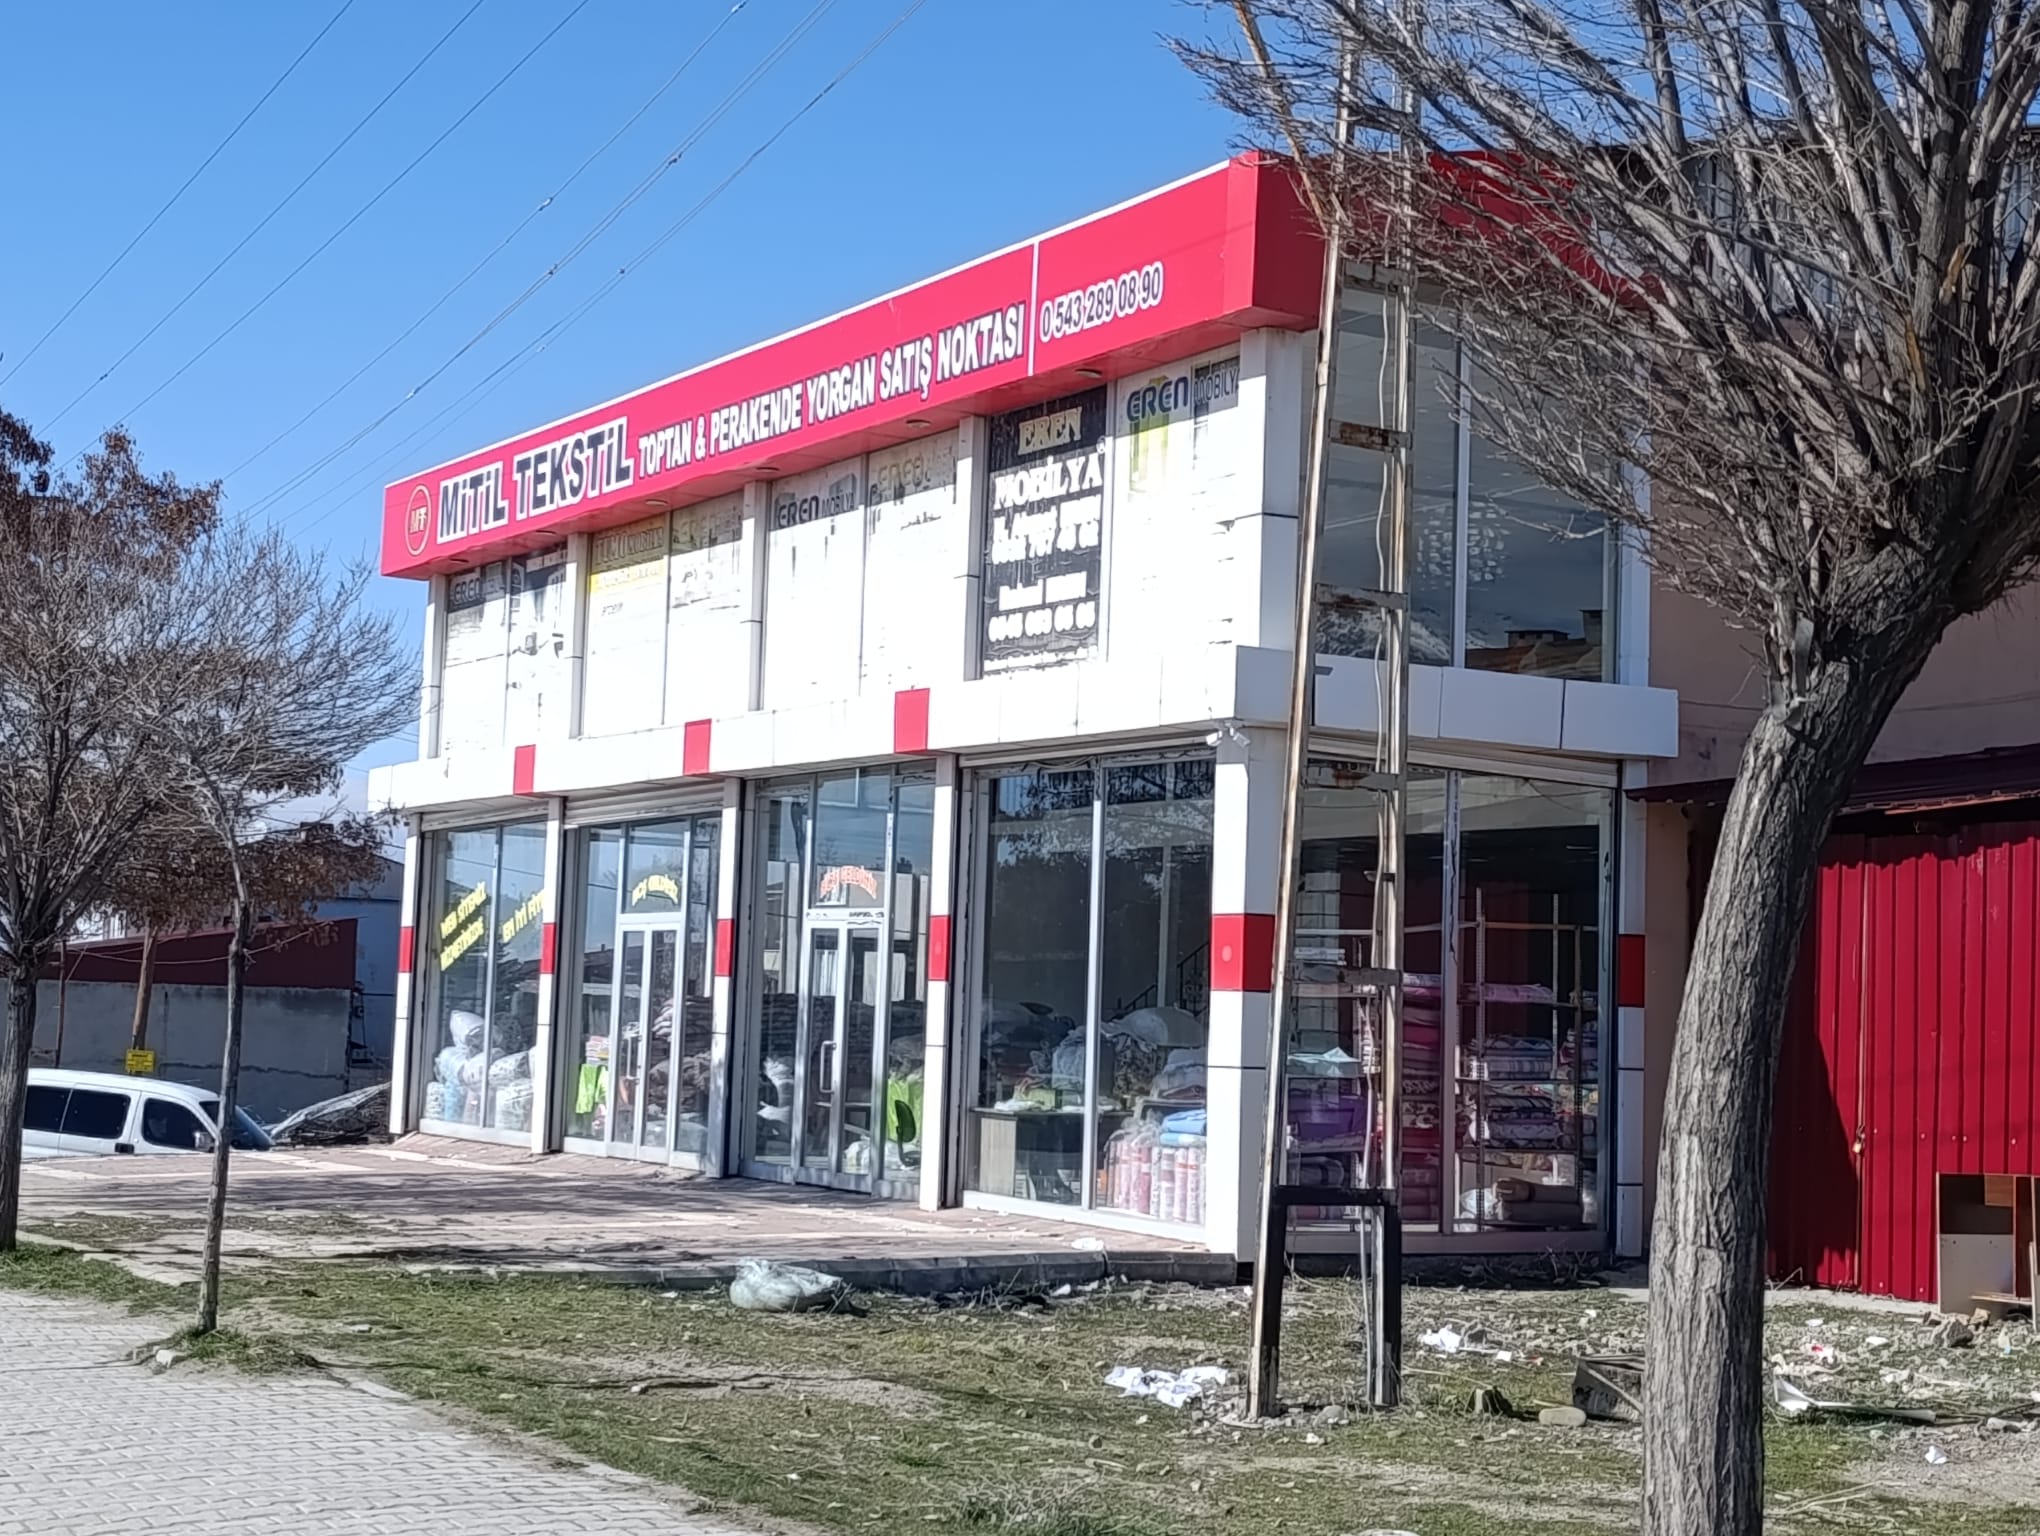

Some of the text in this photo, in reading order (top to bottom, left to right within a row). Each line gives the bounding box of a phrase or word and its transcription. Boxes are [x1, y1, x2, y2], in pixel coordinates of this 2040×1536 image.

[1042, 265, 1162, 339] 0 543 289 08 90
[638, 302, 1026, 479] TOPTAN & PERAKENDE YORGAN SATIŞ NOKTASI
[1126, 376, 1189, 421] EREN
[1018, 406, 1082, 455] EREN
[993, 452, 1102, 510] MOBİLYA
